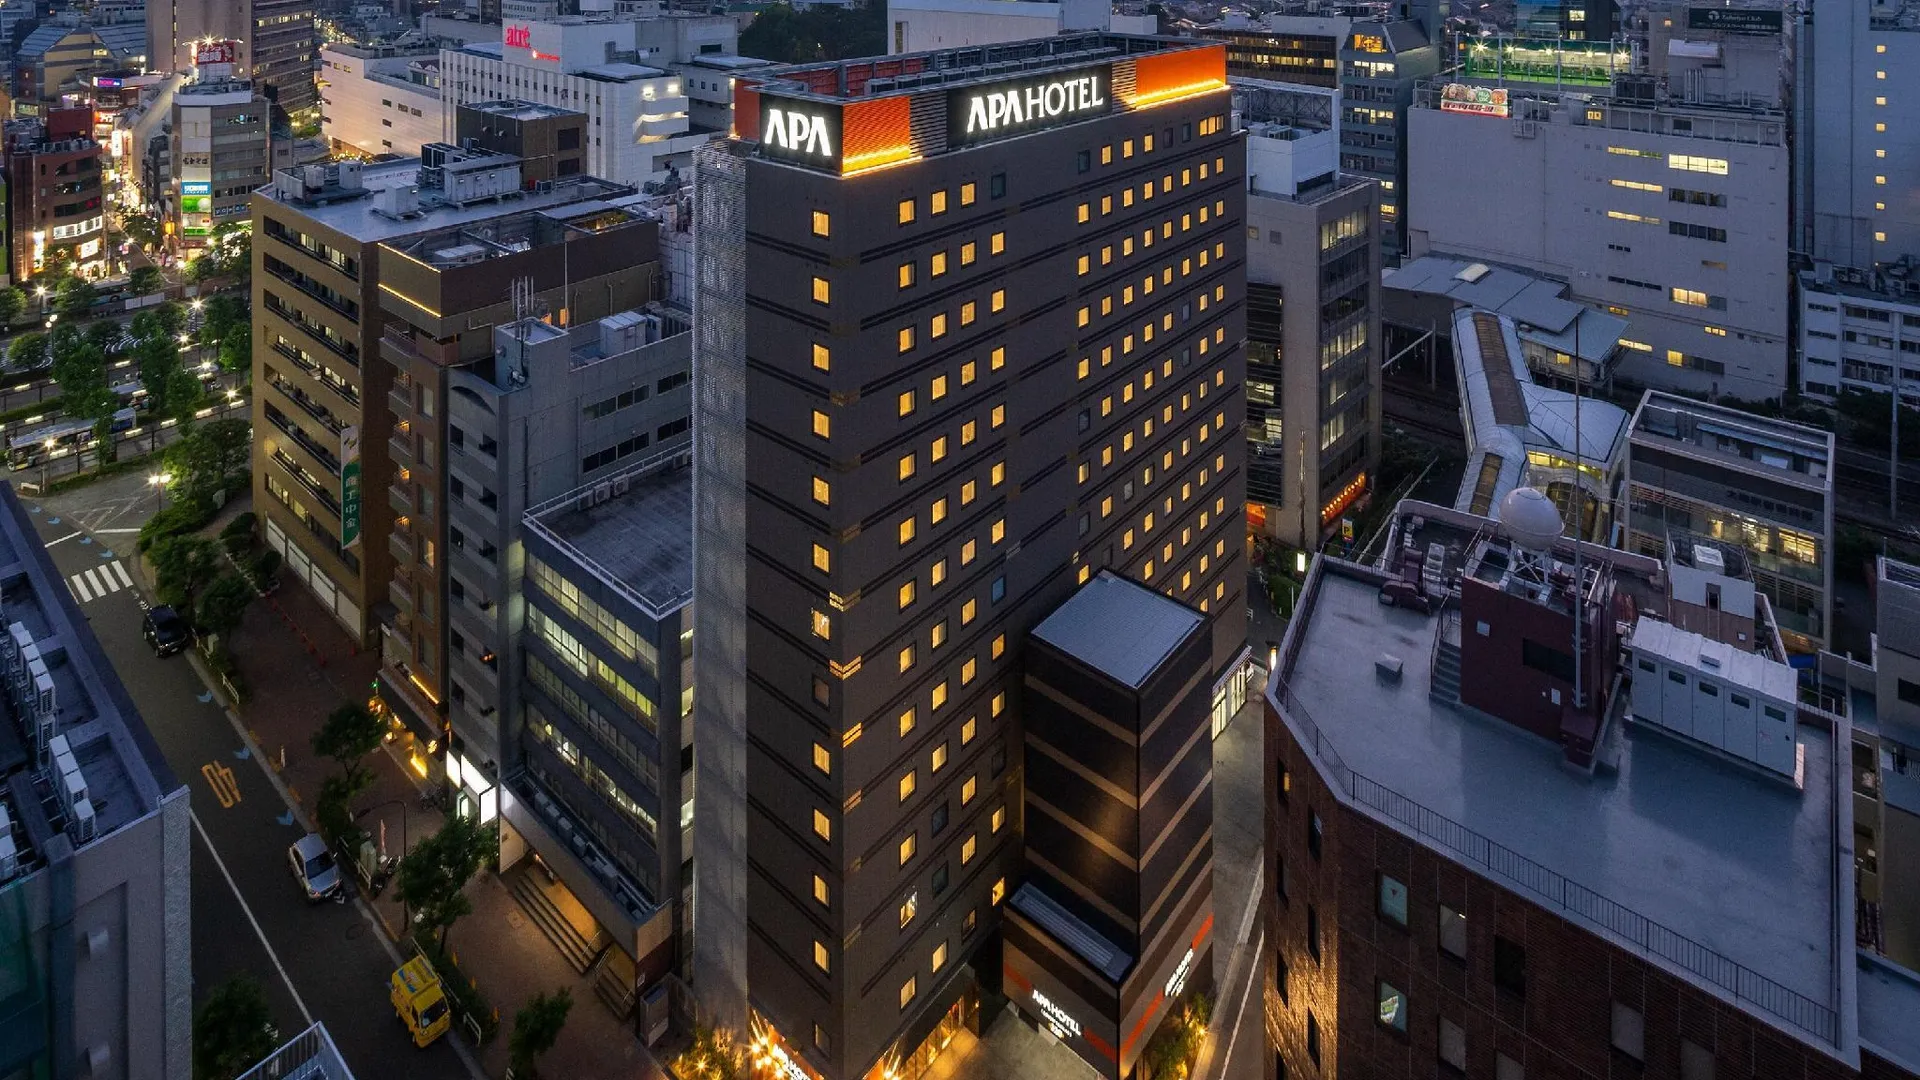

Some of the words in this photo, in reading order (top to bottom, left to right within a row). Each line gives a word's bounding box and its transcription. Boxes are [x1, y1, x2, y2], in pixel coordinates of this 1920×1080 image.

[505, 24, 531, 49] atré
[967, 90, 1024, 133] APA
[1025, 76, 1104, 121] HOTEL
[764, 108, 832, 156] APA
[1344, 526, 1350, 534] P
